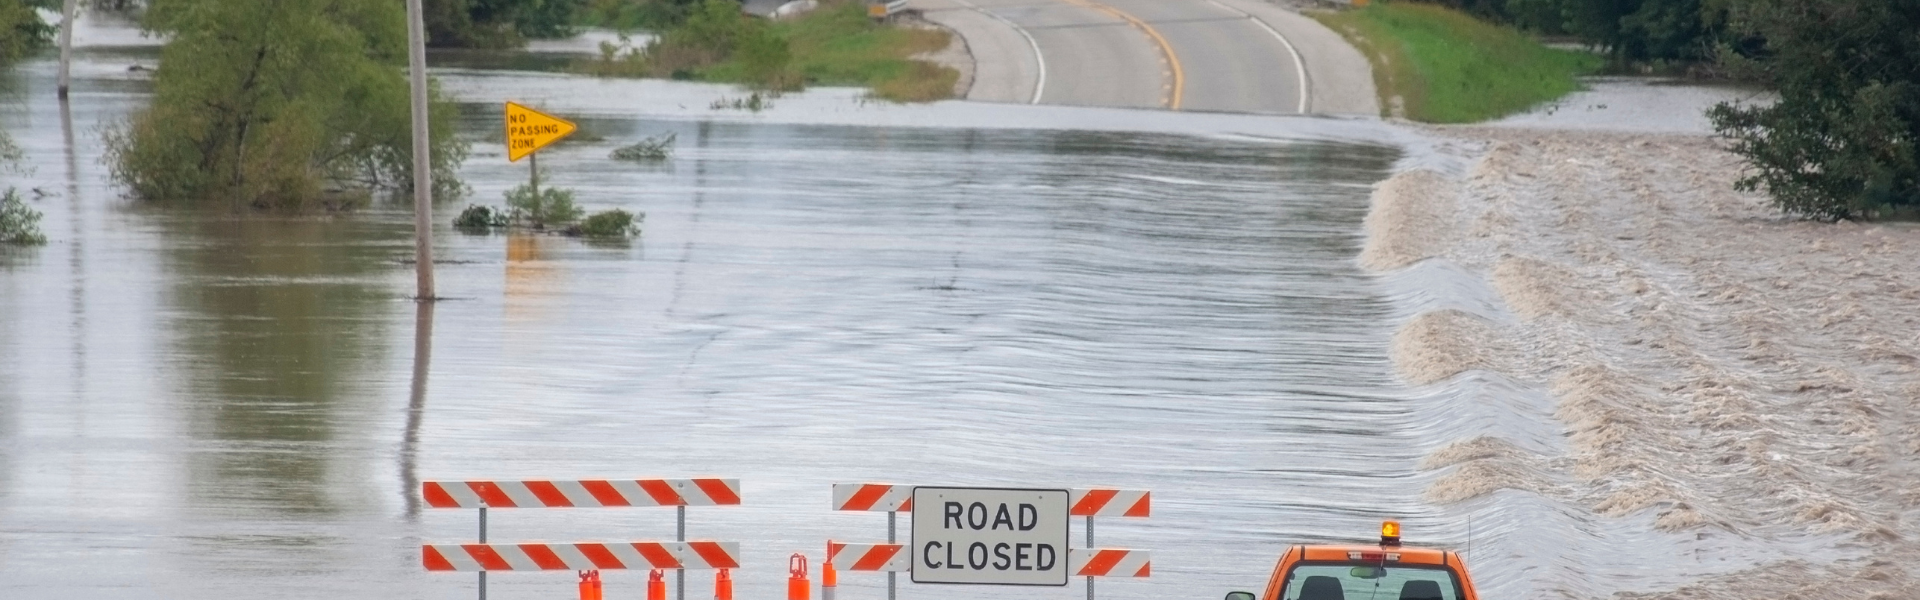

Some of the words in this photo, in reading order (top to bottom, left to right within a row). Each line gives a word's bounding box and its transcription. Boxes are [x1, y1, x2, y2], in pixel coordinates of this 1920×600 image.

[510, 114, 526, 124] NO
[510, 124, 558, 136] PASSING
[511, 139, 535, 149] ZONE
[944, 501, 1038, 531] ROAD
[923, 541, 1056, 571] CLOSED
